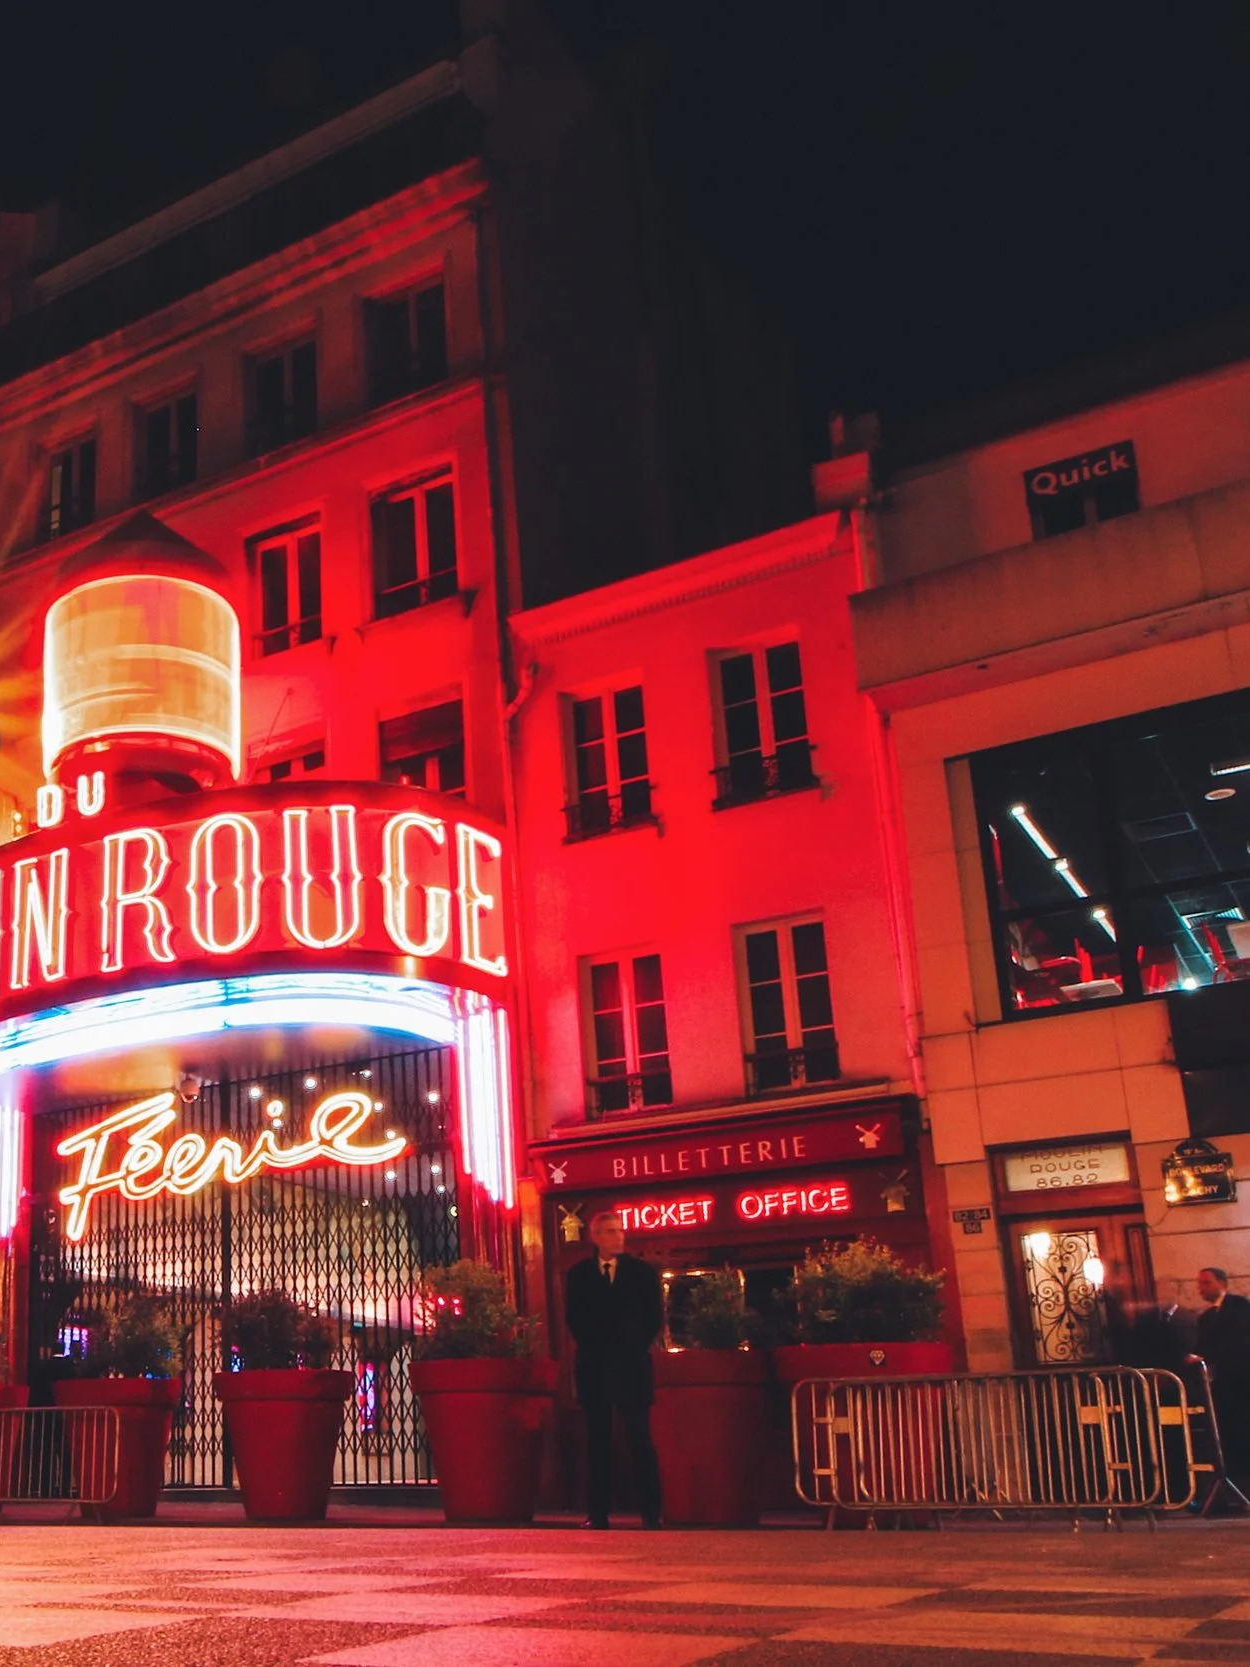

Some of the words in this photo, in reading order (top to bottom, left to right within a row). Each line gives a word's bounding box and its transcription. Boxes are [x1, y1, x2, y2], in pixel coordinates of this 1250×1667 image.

[1031, 450, 1131, 495] Quick
[36, 769, 106, 829] DU
[100, 804, 508, 978] ROUGE
[612, 1136, 808, 1179] BILLETTERIE
[1030, 1158, 1101, 1174] ROUGE
[1036, 1172, 1099, 1190] 86.82
[616, 1199, 713, 1231] TICKET
[741, 1186, 849, 1220] OFFICE
